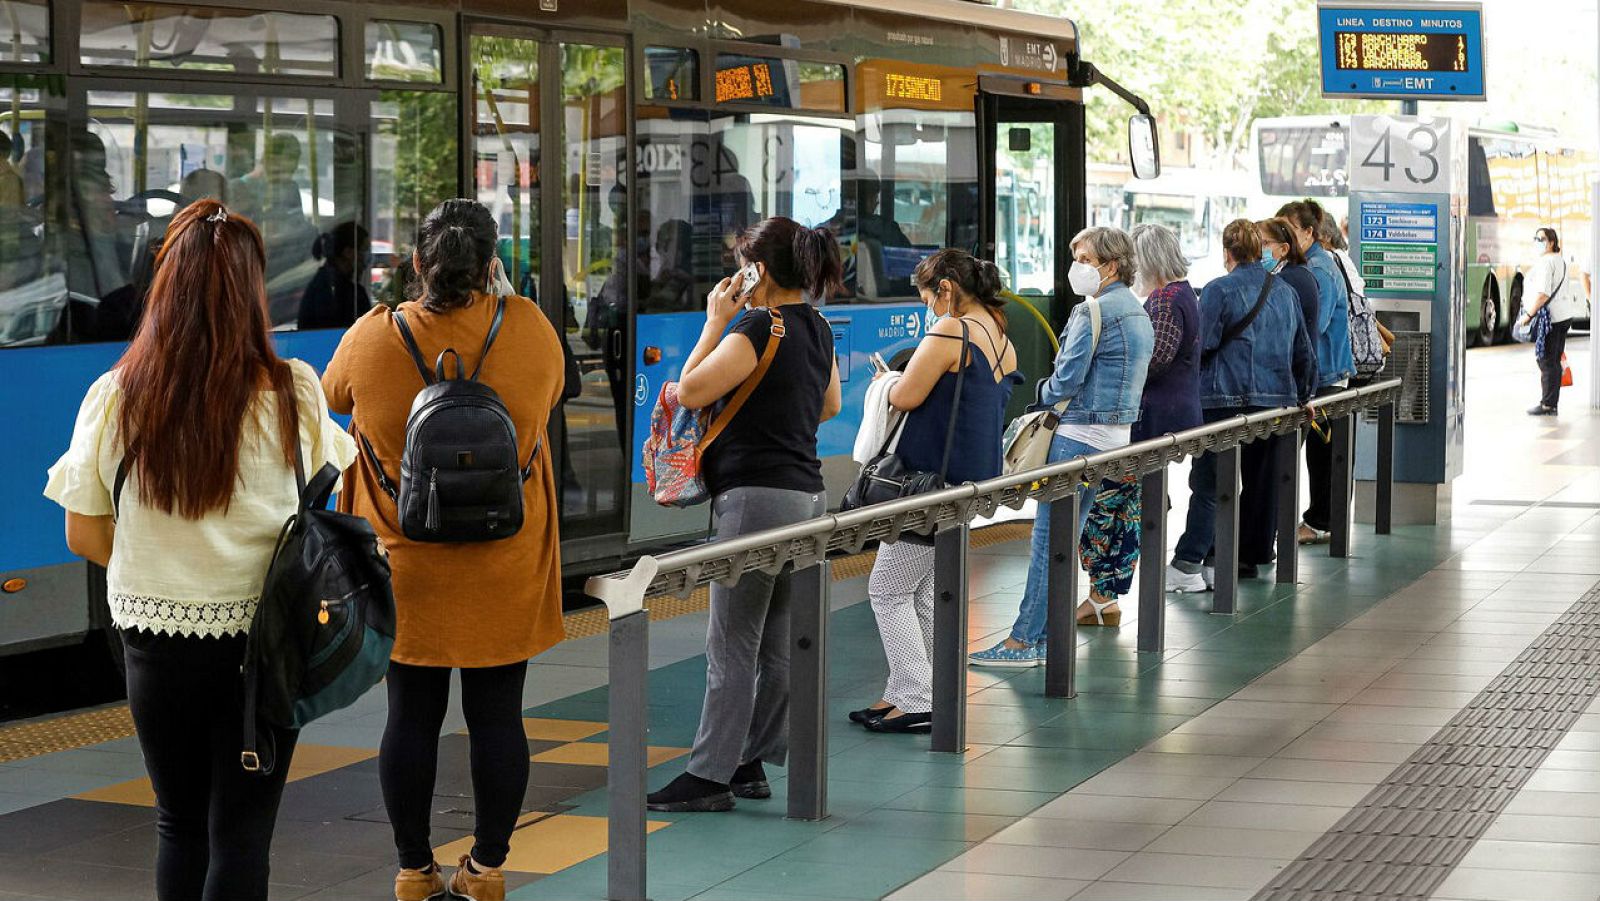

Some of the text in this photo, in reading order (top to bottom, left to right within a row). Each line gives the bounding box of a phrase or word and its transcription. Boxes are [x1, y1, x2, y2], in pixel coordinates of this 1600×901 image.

[1337, 18, 1463, 28] LINEA DESTINO MINUTOS
[1338, 34, 1357, 45] 173
[1361, 34, 1428, 45] SANCHINARRO
[1026, 43, 1041, 54] EMT
[1015, 54, 1043, 69] MADRID
[1363, 59, 1429, 70] SANCHINARRO
[1405, 77, 1434, 90] EMT
[1361, 124, 1439, 185] 43
[1367, 216, 1383, 225] 173
[1367, 229, 1383, 238] 174
[890, 314, 905, 326] EMT
[879, 327, 905, 338] MADRID
